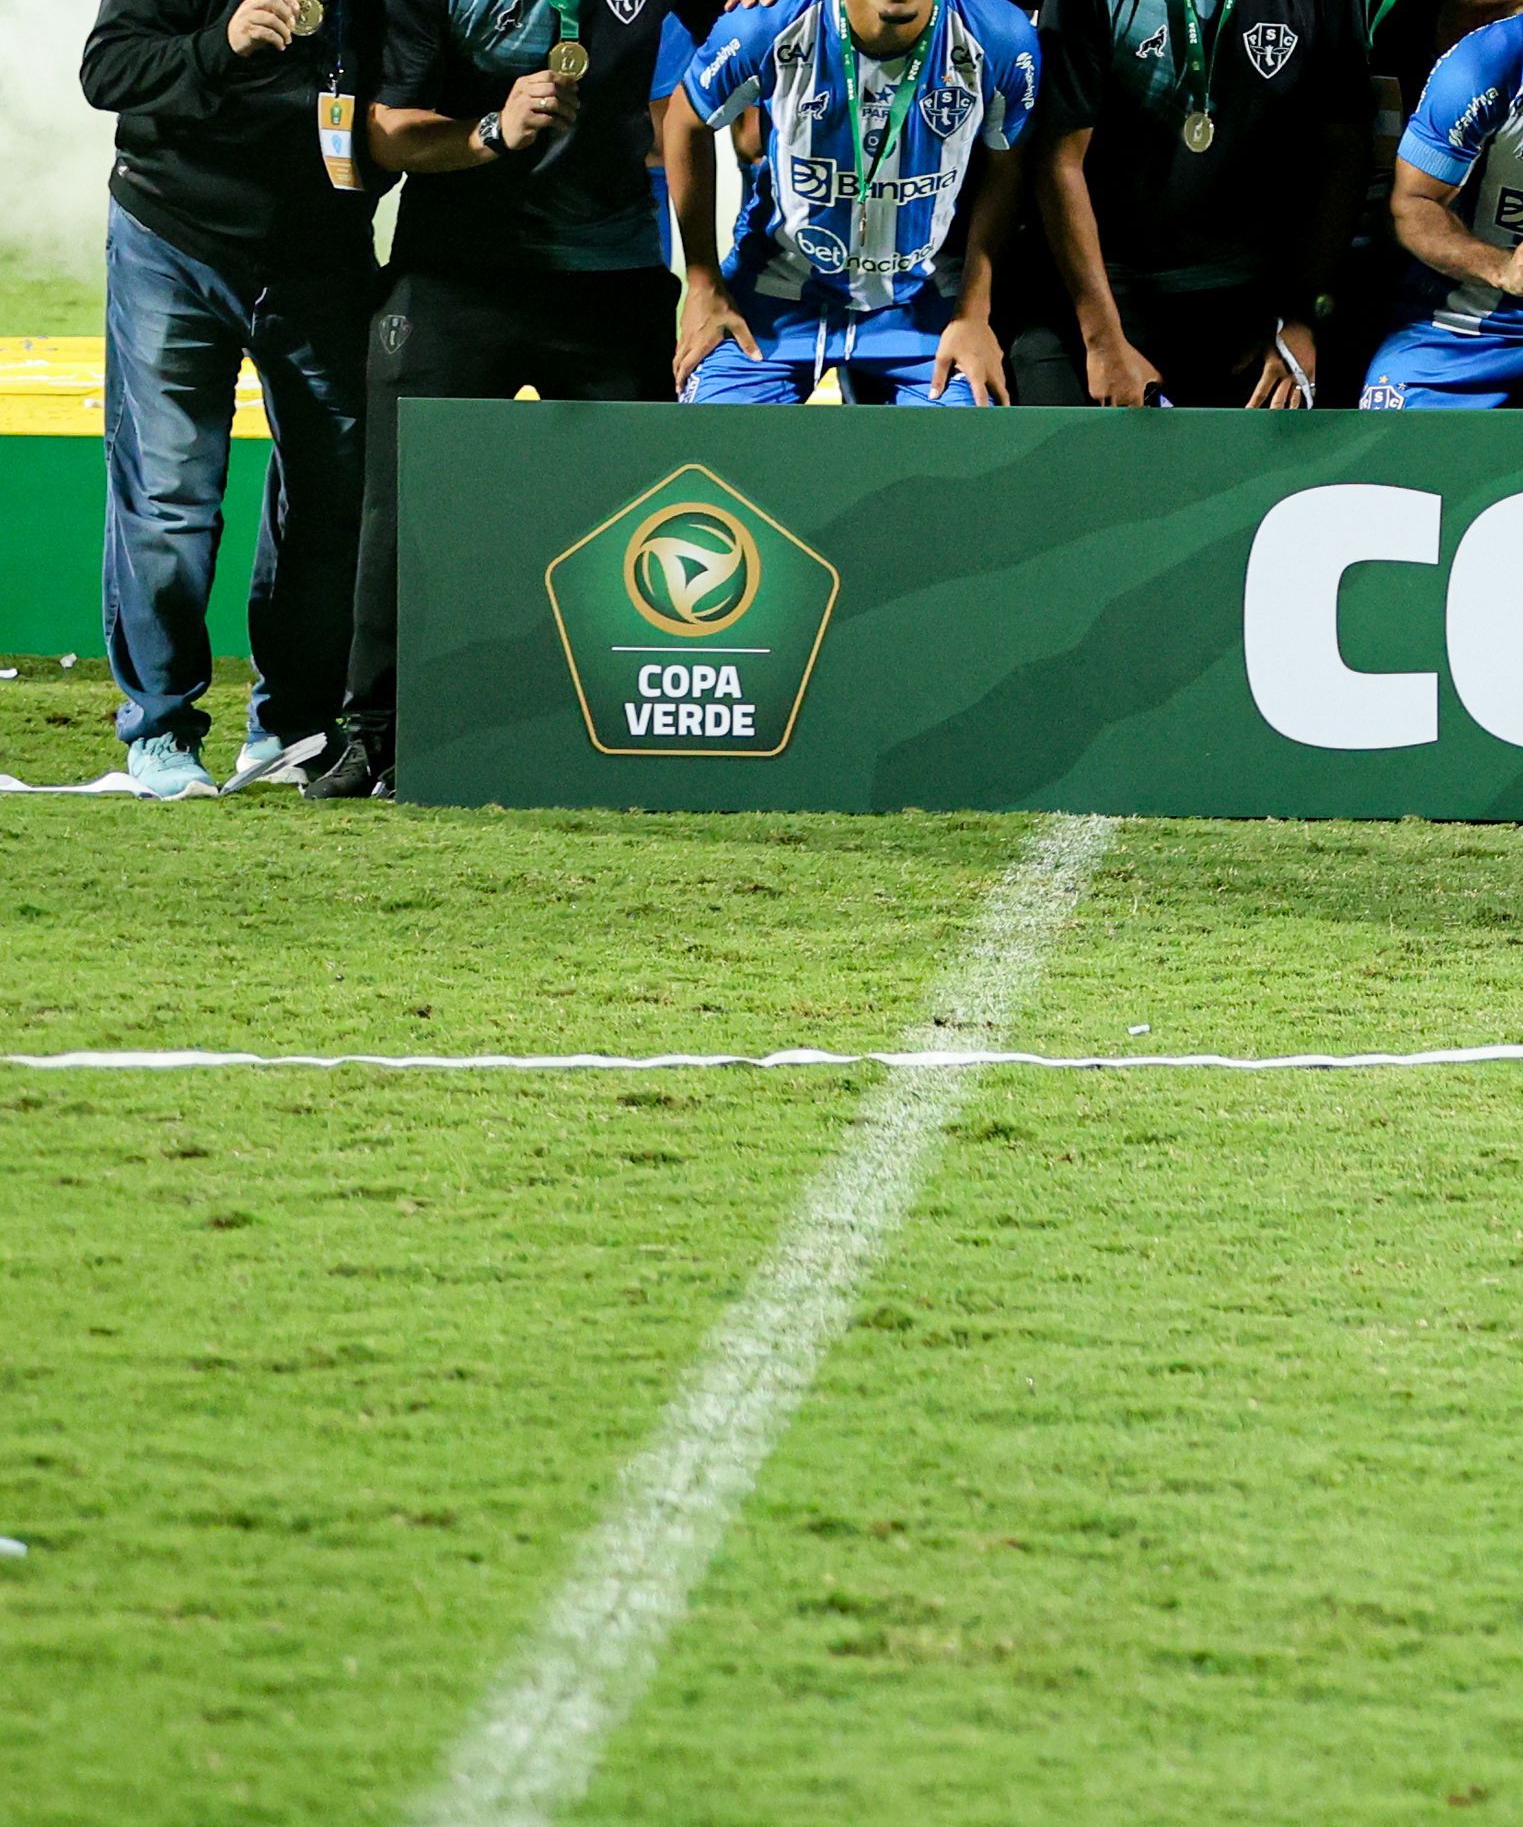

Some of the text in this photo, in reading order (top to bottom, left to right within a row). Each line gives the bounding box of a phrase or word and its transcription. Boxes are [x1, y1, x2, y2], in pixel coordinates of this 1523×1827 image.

[1189, 22, 1198, 44] 2024
[1248, 29, 1294, 48] PSC
[777, 43, 814, 64] GAV
[907, 59, 922, 81] 2024
[924, 90, 971, 109] PSC
[797, 235, 936, 273] bet nacional
[638, 664, 741, 698] COPA
[624, 702, 756, 738] VERDE
